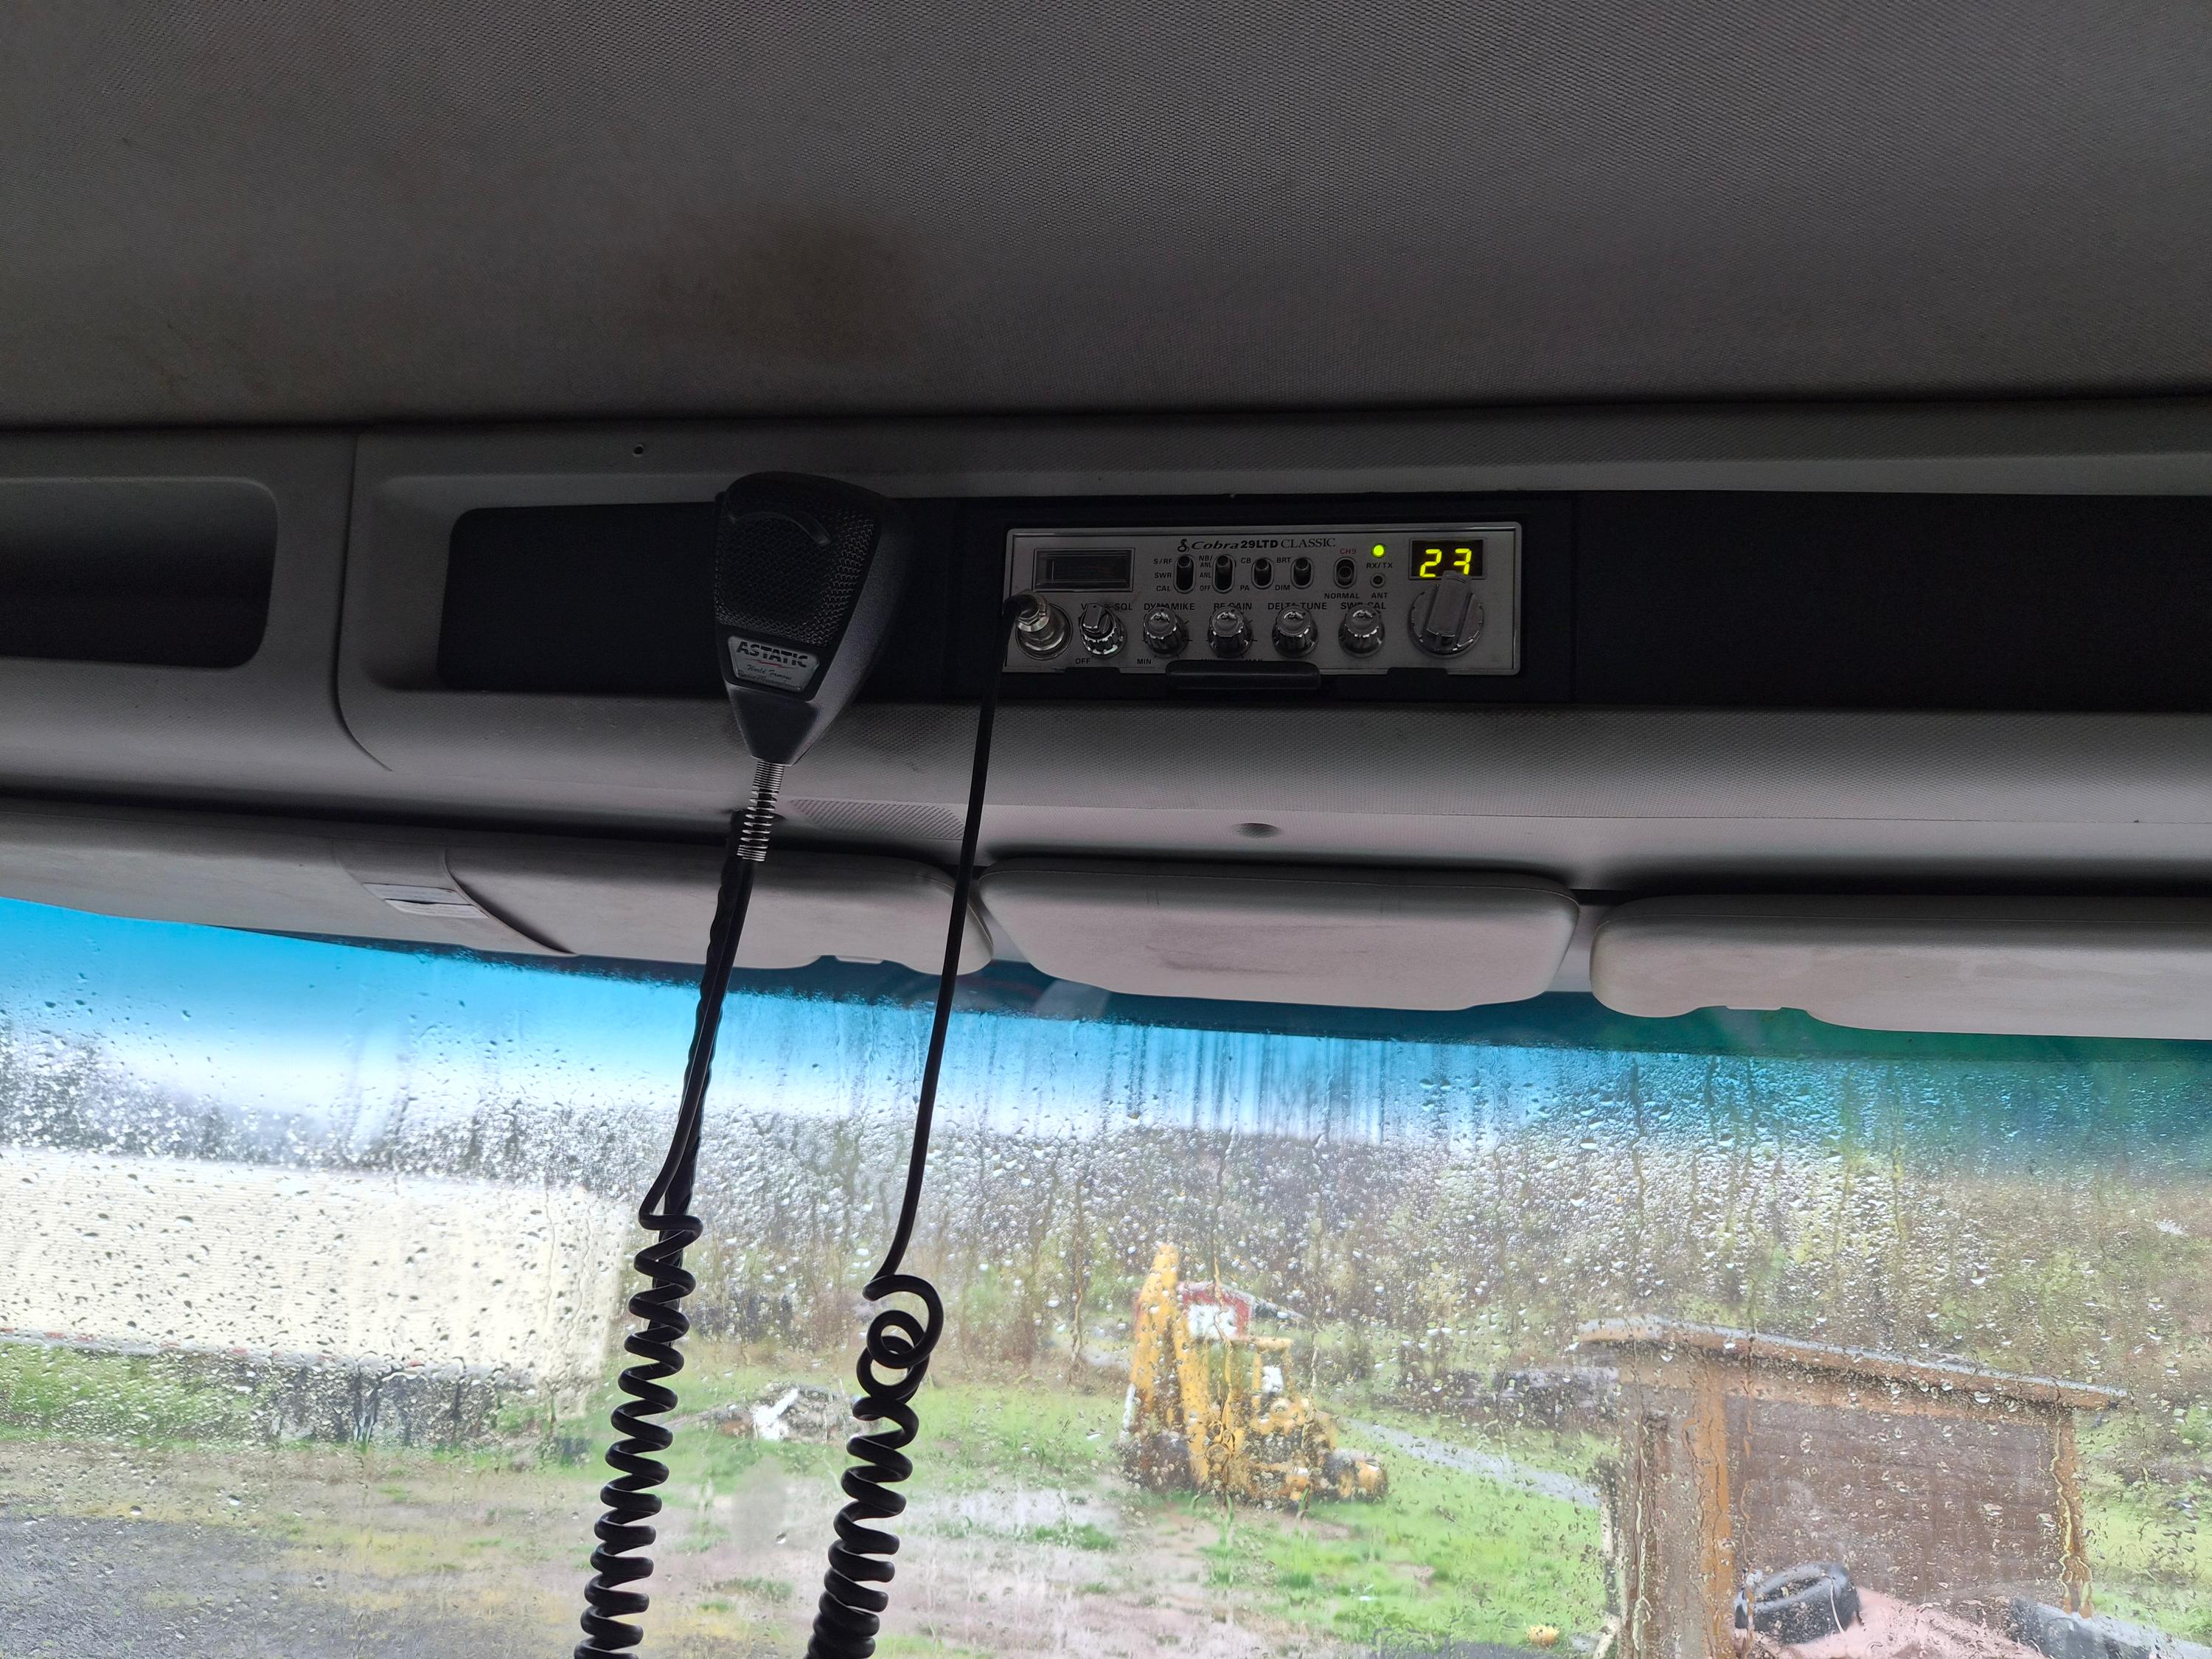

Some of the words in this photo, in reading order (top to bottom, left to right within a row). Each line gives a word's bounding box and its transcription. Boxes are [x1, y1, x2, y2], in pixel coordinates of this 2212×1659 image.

[1191, 540, 1239, 550] Cobra
[1280, 538, 1336, 549] CLASSIC
[736, 641, 808, 668] ASTATIC
